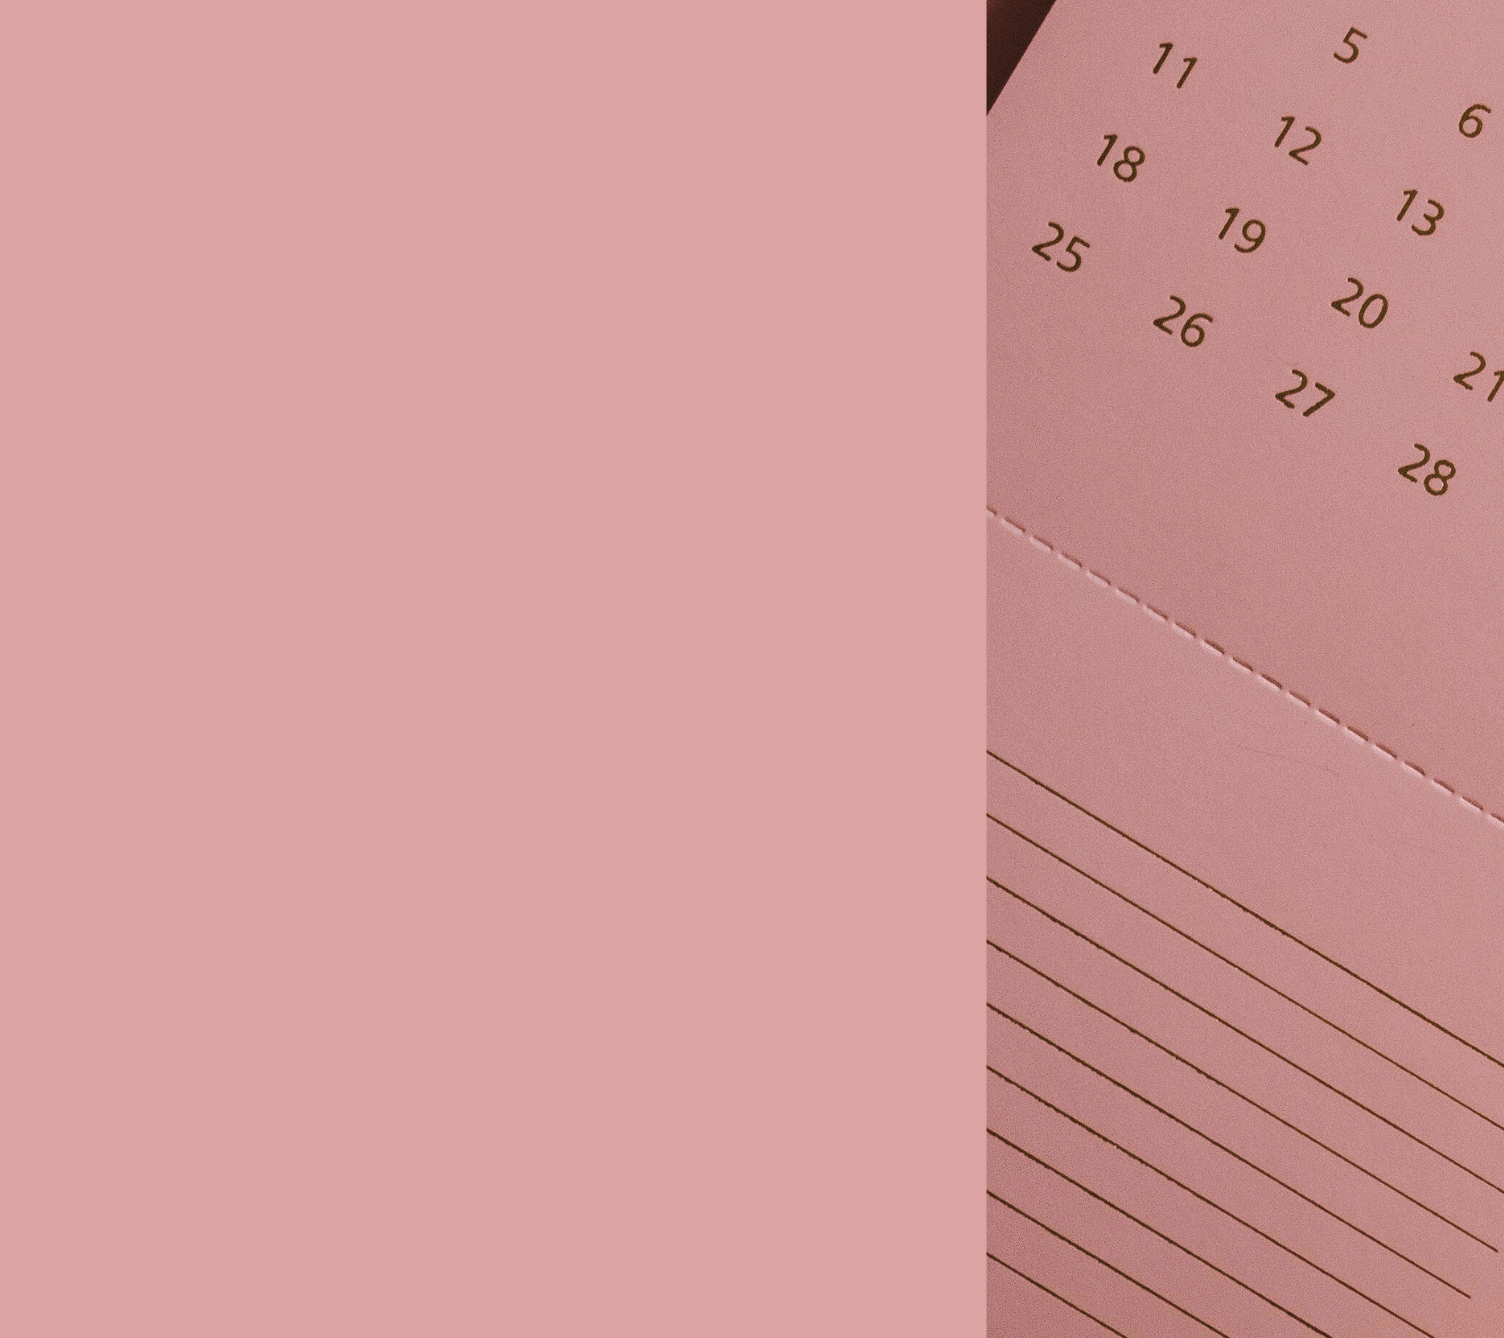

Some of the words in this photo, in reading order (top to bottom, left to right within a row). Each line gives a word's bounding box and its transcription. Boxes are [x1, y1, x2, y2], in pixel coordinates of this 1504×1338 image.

[1153, 43, 1197, 88] 11
[1275, 116, 1321, 165] 12
[1397, 190, 1444, 236] 13
[1334, 27, 1367, 63] 5
[1459, 104, 1491, 138] 6
[1097, 134, 1145, 182] 18
[1219, 208, 1266, 253] 19
[1331, 278, 1388, 328] 20
[1032, 222, 1090, 272] 25
[1153, 296, 1213, 347] 26
[1275, 370, 1335, 417] 27
[1398, 444, 1456, 496] 28
